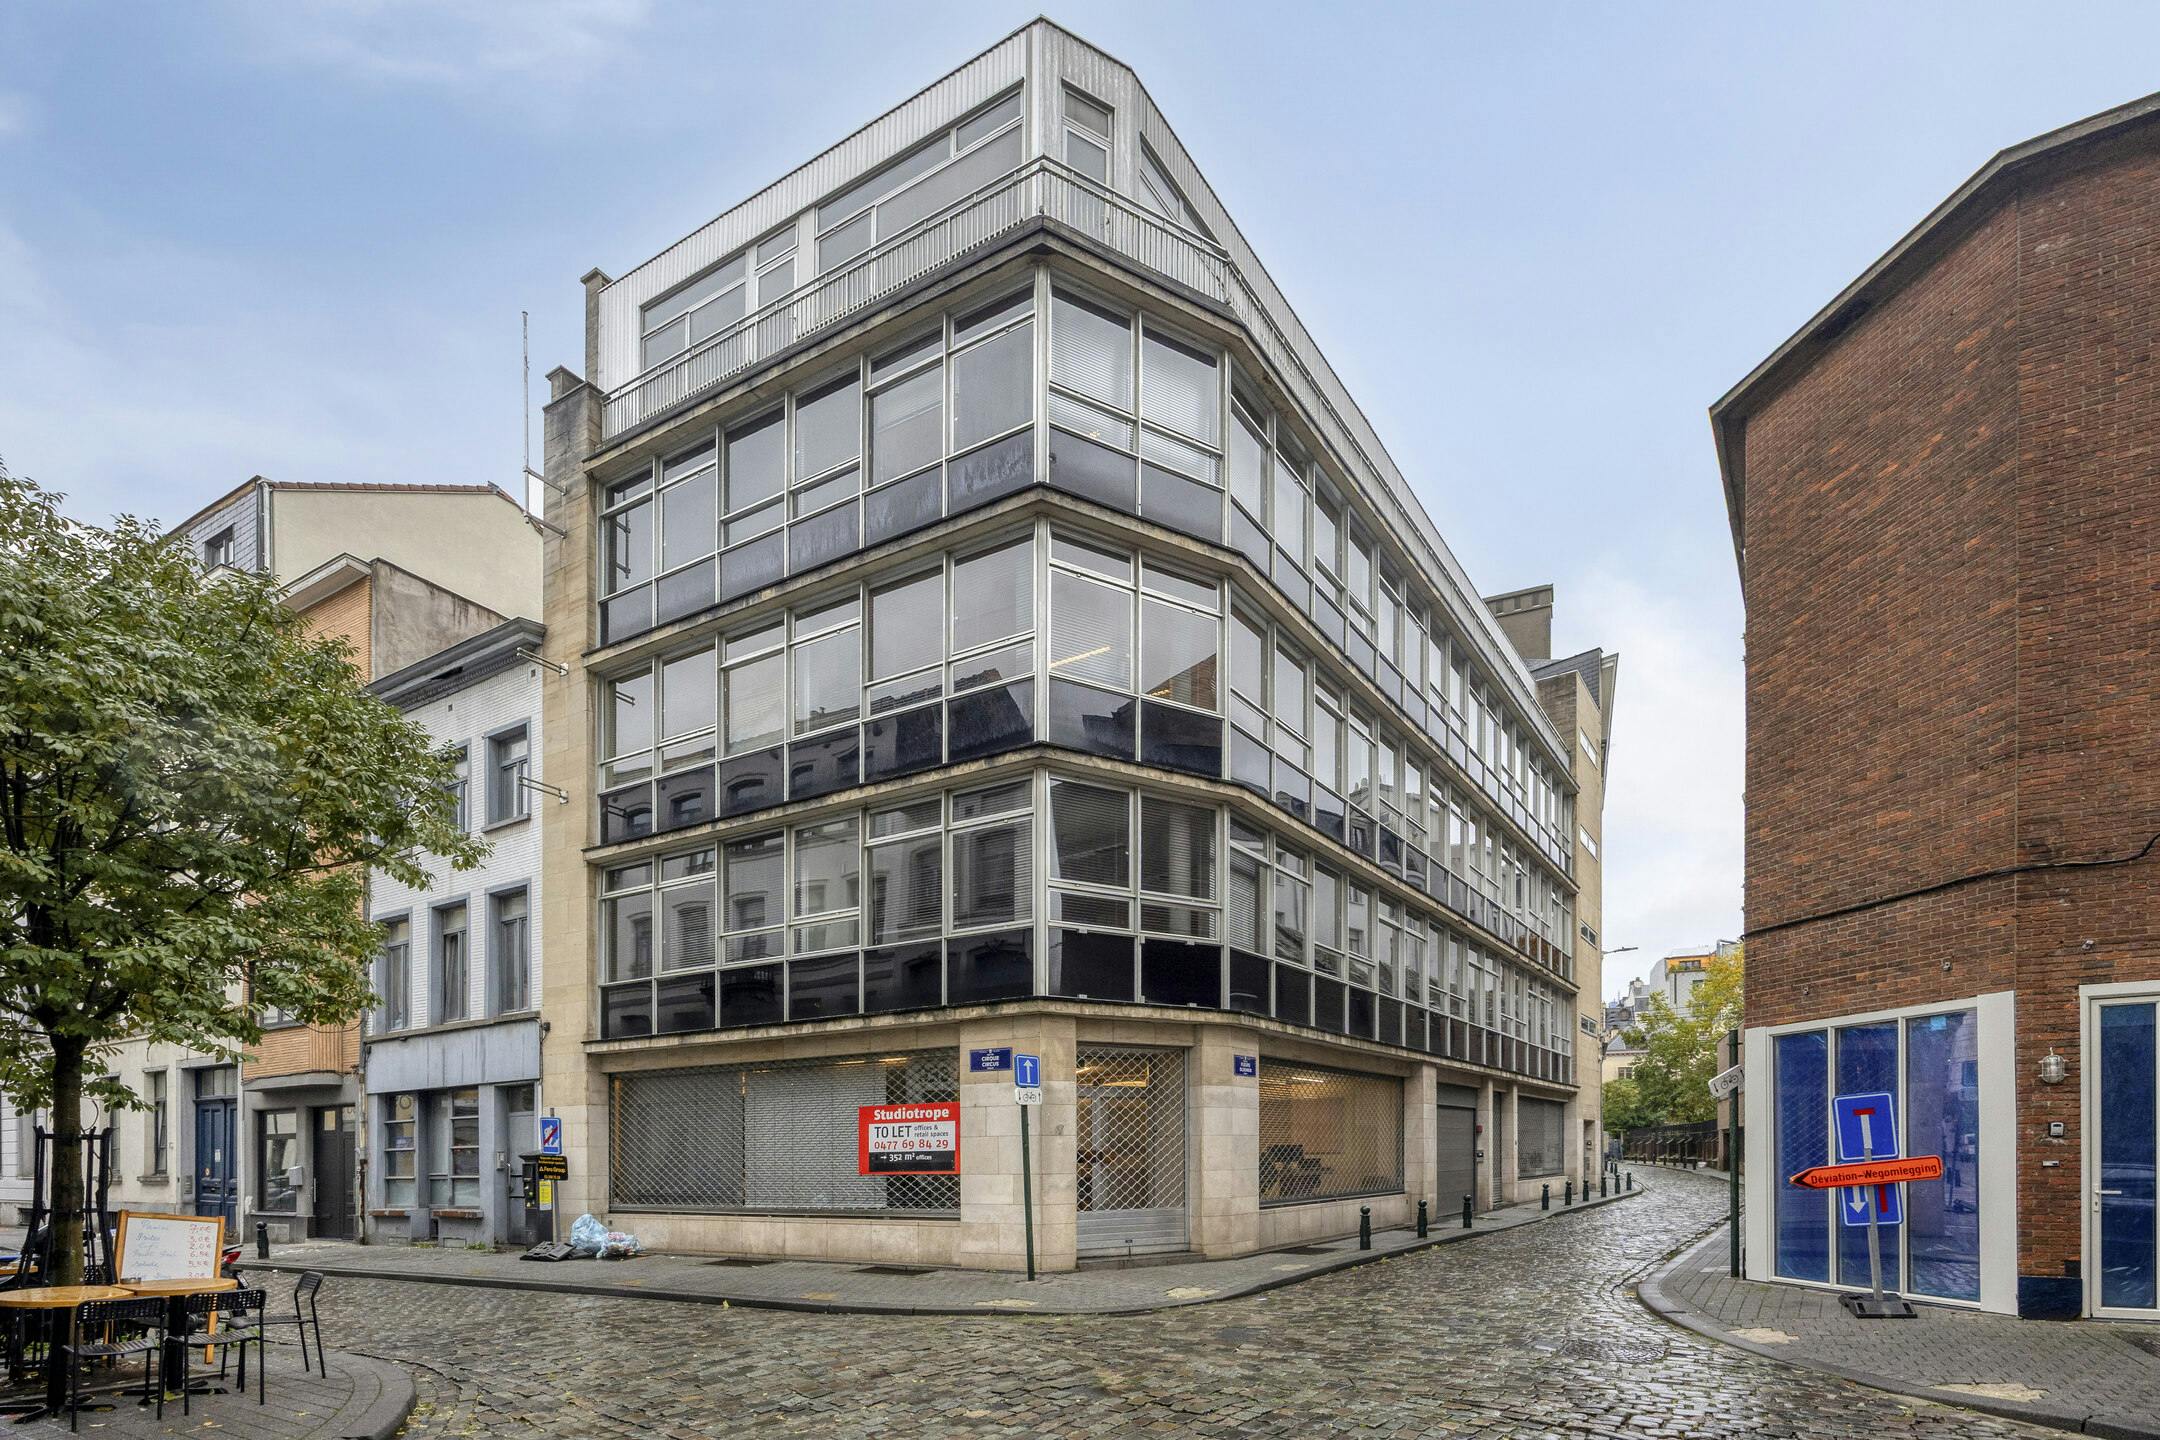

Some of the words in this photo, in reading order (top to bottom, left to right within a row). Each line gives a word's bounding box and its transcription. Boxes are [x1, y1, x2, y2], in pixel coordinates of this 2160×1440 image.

[874, 1107, 949, 1120] Studiotrope
[874, 1126, 889, 1138] TO
[892, 1125, 912, 1138] LET
[874, 1141, 898, 1150] 0477
[902, 1139, 914, 1150] 69
[918, 1139, 932, 1149] 84
[936, 1139, 949, 1149] 29
[889, 1154, 902, 1162] 352
